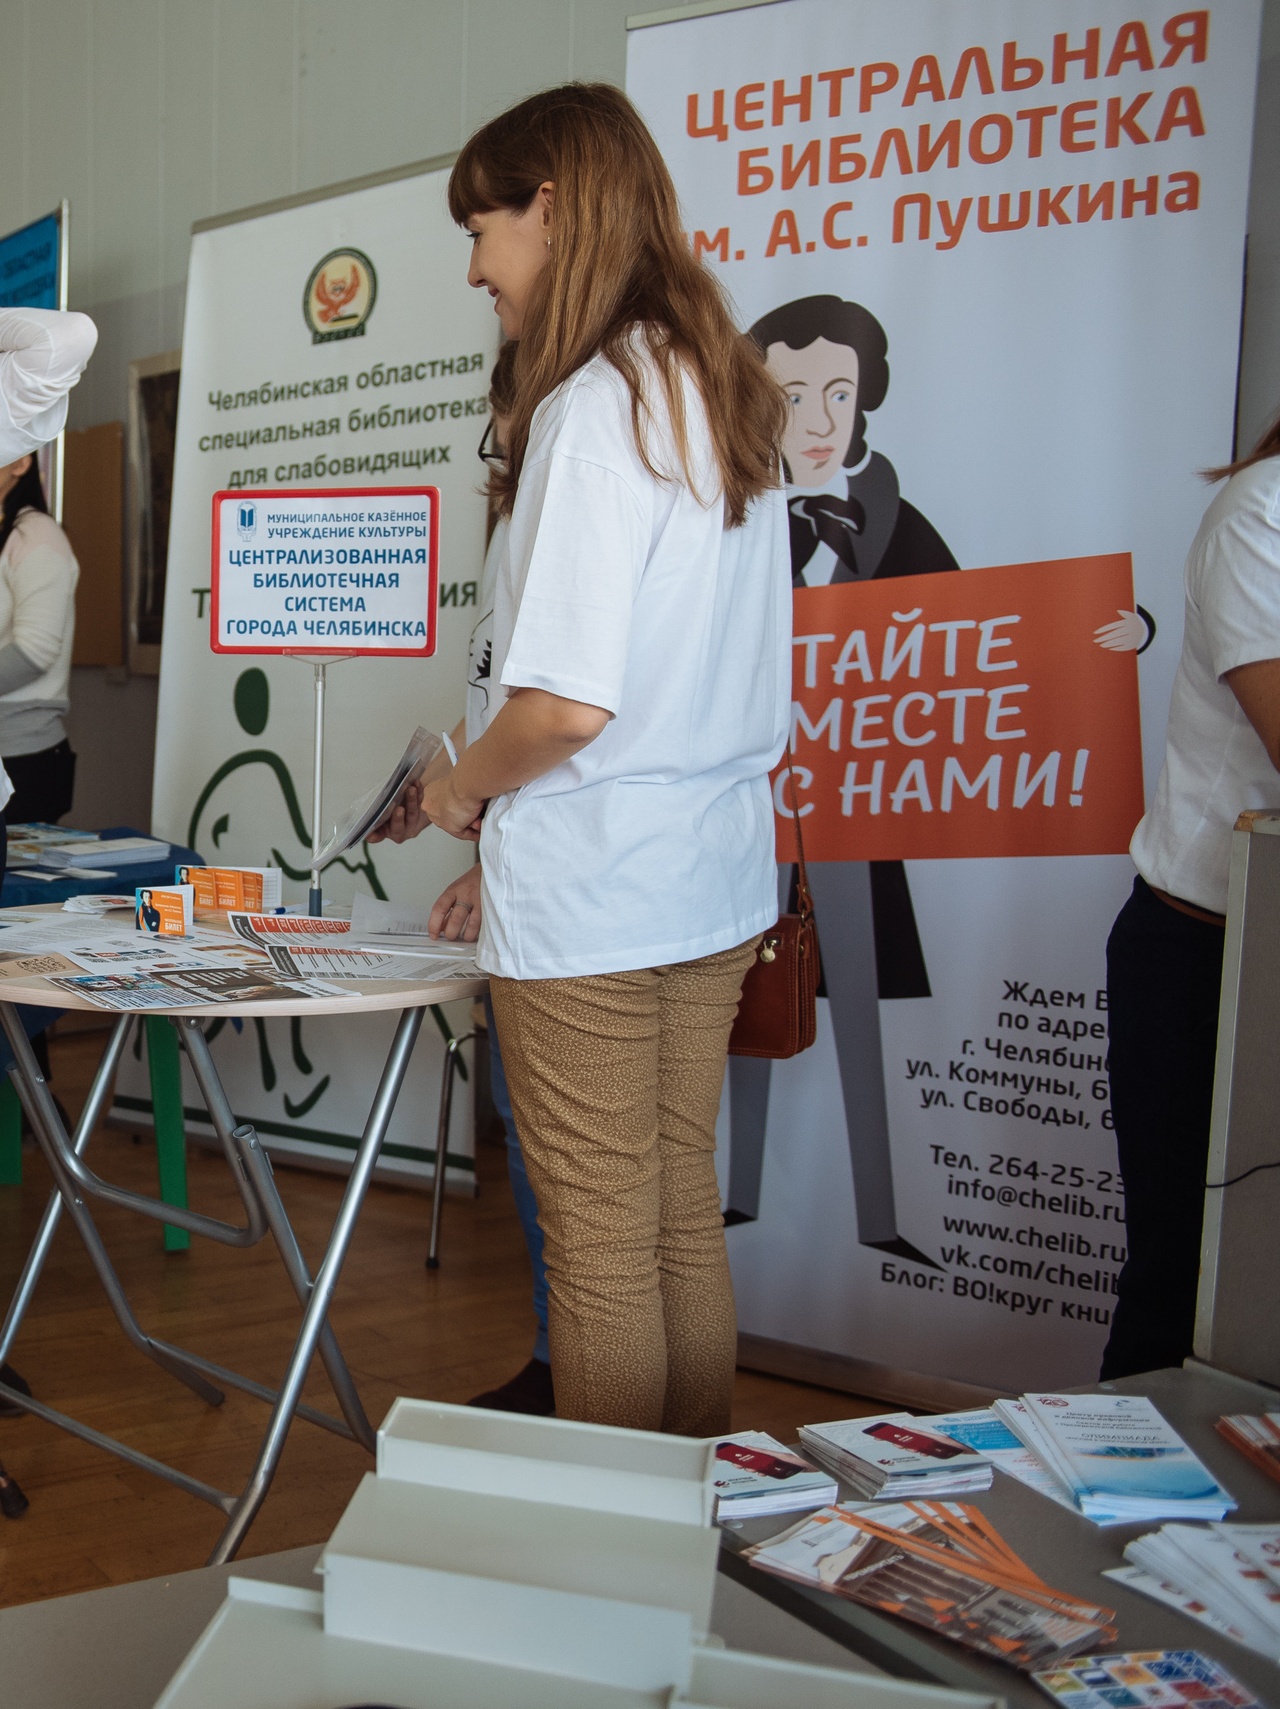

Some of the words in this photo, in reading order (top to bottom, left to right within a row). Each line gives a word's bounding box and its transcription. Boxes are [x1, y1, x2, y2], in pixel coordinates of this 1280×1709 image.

[685, 9, 1211, 143] ЦЕНТРАЛЬНАЯ
[737, 85, 1205, 196] БИБЛИОТЕКА
[681, 227, 745, 263] м.
[764, 201, 868, 258] А.С.
[892, 170, 1200, 251] Пушкина
[208, 373, 349, 412] Челябинская
[356, 352, 484, 390] областная
[199, 416, 341, 454] специальная
[348, 395, 487, 432] библиотека
[228, 466, 268, 490] для
[274, 443, 451, 483] слабовидящих
[267, 511, 364, 525] МУНИЦИПАЛЬНОЕ
[367, 509, 426, 523] КАЗЁННОЕ
[267, 526, 355, 539] УЧРЕЖДЕНИЕ
[358, 524, 426, 538] КУЛЬТУРЫ
[228, 549, 426, 567] ЦЕНТРАЛИЗОВАННАЯ
[253, 573, 400, 588] БИБЛИОТЕЧНАЯ
[284, 597, 366, 612] СИСТЕМА
[226, 619, 298, 637] ГОРОДА
[304, 620, 426, 637] ЧЕЛЯБИНСКА
[792, 607, 1021, 688] ТАЙТЕ
[789, 683, 1030, 756] МЕСТЕ
[773, 766, 815, 818] С
[839, 748, 1089, 817] НАМИ!
[164, 922, 182, 932] БИЛЕТ
[1002, 980, 1085, 1009] Ждем
[998, 1012, 1029, 1030] по
[962, 1039, 974, 1055] г.
[906, 1059, 939, 1079] ул.
[949, 1060, 1081, 1100] Коммуны,
[920, 1088, 954, 1108] ул.
[963, 1091, 1090, 1129] Свободы,
[930, 1144, 979, 1171] Тел.
[947, 1174, 1126, 1223] info@chelib.ru
[943, 1216, 1126, 1263] www.chelib.ru
[881, 1262, 944, 1292] Блог:
[953, 1276, 1053, 1316] ВО!круг
